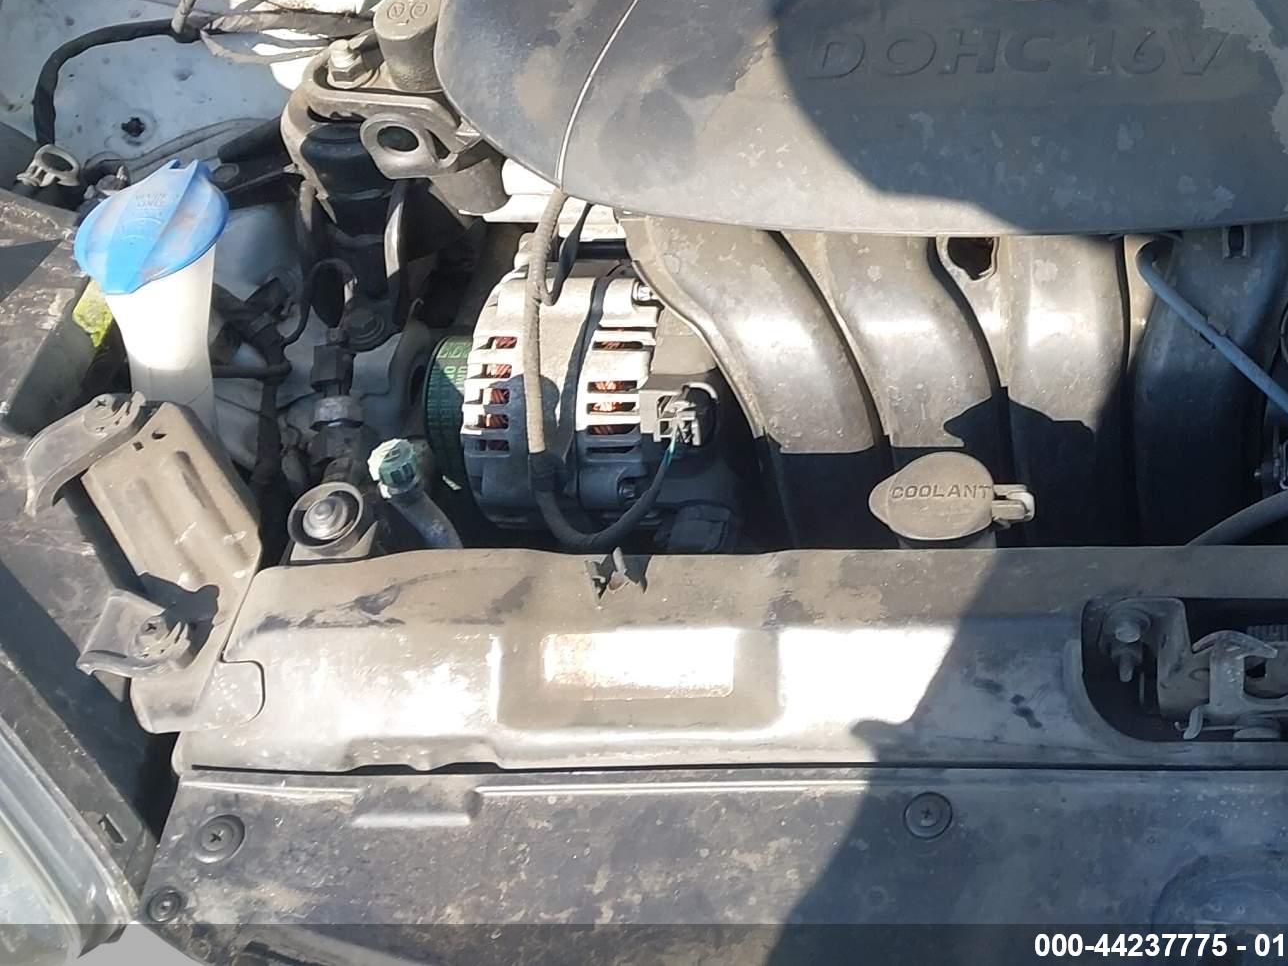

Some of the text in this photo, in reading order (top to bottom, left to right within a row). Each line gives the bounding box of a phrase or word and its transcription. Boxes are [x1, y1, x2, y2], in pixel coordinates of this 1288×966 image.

[803, 27, 1231, 79] DOHC 16V
[891, 484, 992, 500] COOLANT
